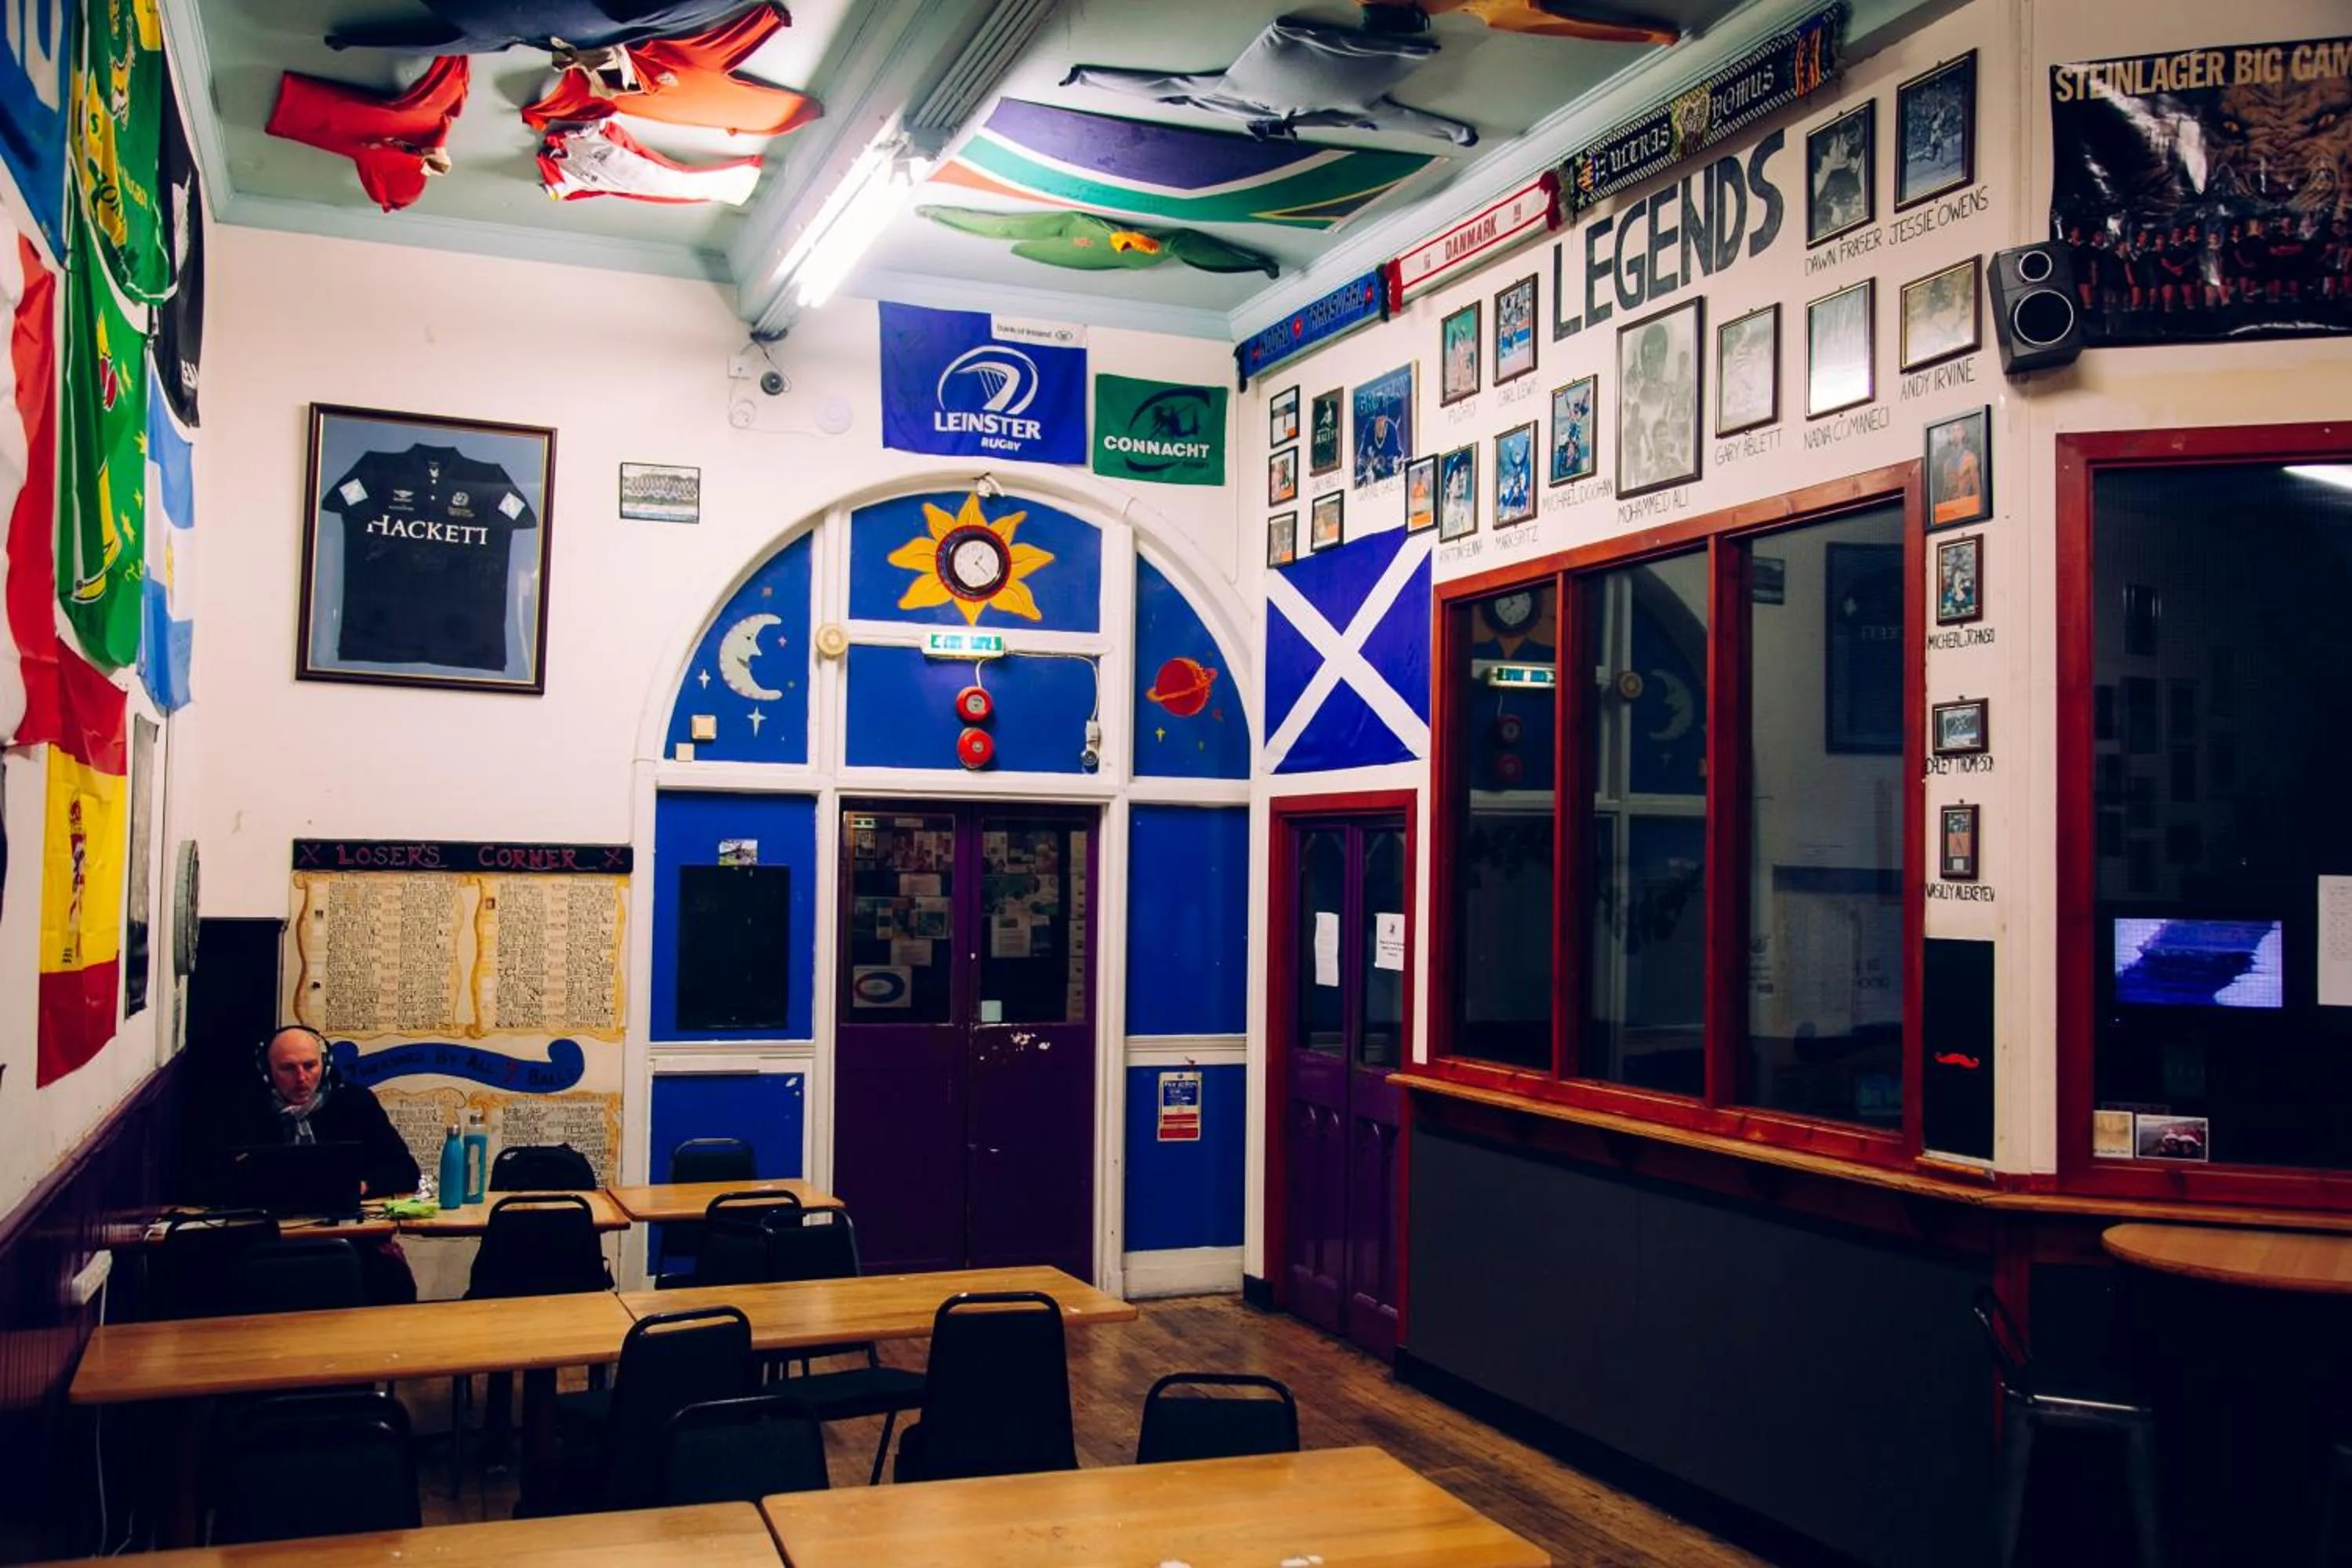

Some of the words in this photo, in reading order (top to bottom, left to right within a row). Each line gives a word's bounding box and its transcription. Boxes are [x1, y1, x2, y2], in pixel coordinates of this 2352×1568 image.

[2055, 51, 2226, 103] STEINLAGER
[2235, 45, 2283, 85] BIG
[1889, 209, 1936, 245] JESSIE
[1937, 186, 1990, 226] OWENS
[1445, 214, 1497, 260] DANMARK
[1553, 127, 1785, 343] LEGENDS
[1806, 249, 1836, 275] DAWN
[1839, 228, 1883, 263] FRASER
[1900, 372, 1931, 402] ANDY
[1934, 358, 1975, 391] IRVINE
[935, 412, 1041, 439] LEINSTER
[981, 437, 1021, 452] RUGBY
[1104, 435, 1210, 459] CONNACHT
[1715, 439, 1740, 466] GARY
[1743, 429, 1781, 457] ABLETT
[1673, 487, 1690, 508] ALI
[366, 514, 488, 545] HACKETT
[478, 845, 582, 869] CORNER
